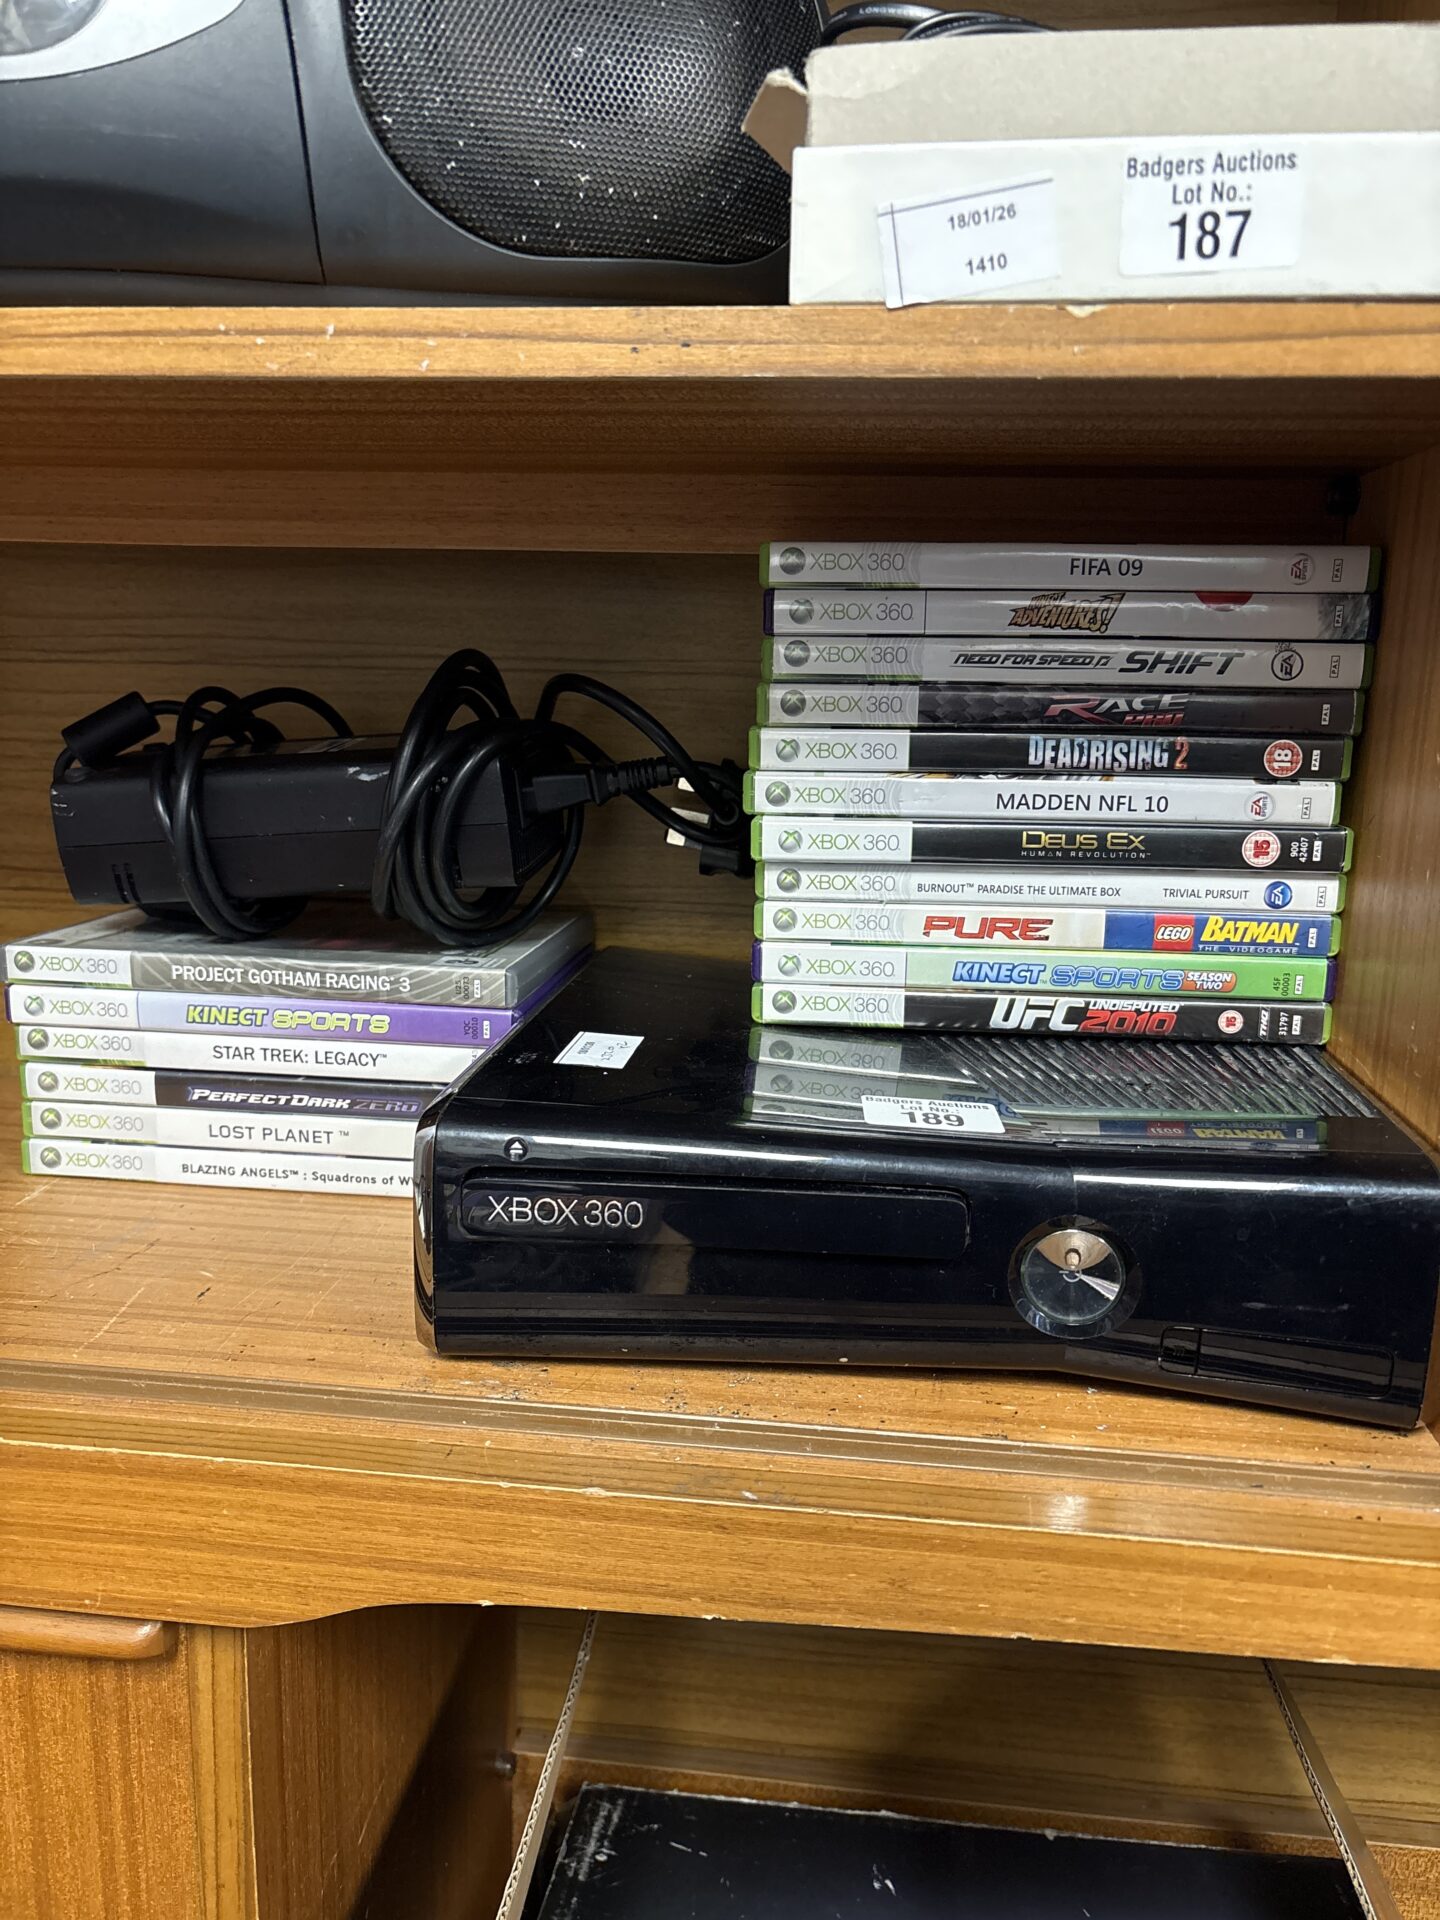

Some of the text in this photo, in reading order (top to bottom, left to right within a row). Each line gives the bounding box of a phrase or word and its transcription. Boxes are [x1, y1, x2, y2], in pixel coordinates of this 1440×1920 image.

[1126, 150, 1297, 179] Badgers Auctions
[1171, 182, 1252, 205] Lot No.:
[947, 204, 1017, 231] 18/01/26
[1169, 210, 1252, 261] 187
[965, 254, 1008, 275] 1410
[810, 553, 905, 571] XBOX 360
[1070, 558, 1143, 576] FIFA 09
[1334, 561, 1342, 579] PAL
[819, 603, 913, 620] XBOX 360
[814, 646, 909, 663] XBOX 360
[954, 651, 1245, 675] NEED FOR SPEED SHIFT
[810, 695, 903, 713] XBOX 360
[1044, 693, 1189, 725] RACE
[1321, 704, 1331, 724] PAL
[805, 742, 897, 759] XBOX 360
[1174, 736, 1190, 770] 2
[1273, 749, 1292, 769] 18
[794, 787, 886, 805] XBOX 360
[996, 793, 1169, 812] MADDEN NFL 10
[807, 834, 900, 851] XBOX 360
[1022, 831, 1098, 849] DEUS
[1253, 840, 1270, 858] 15
[1290, 842, 1299, 857] 900
[1299, 837, 1309, 862] 42407
[806, 875, 896, 892] XBOX 360
[977, 885, 1023, 895] PARADISE
[1028, 886, 1046, 895] THE
[1049, 886, 1097, 896] ULTIMATE
[1100, 887, 1121, 897] BOX
[1163, 888, 1249, 900] TRIVIAL PURSUIT
[801, 912, 891, 931] XBOX 360
[923, 915, 1054, 941] PURE
[1200, 916, 1299, 944] BATMAN
[1156, 926, 1192, 940] LEGO
[1229, 946, 1299, 954] VIDEOGAME
[39, 956, 117, 974] XBOX 360
[806, 959, 895, 977] XBOX 360
[172, 965, 244, 983] PROJECT
[248, 970, 321, 988] GOTHAM
[399, 978, 410, 992] 3
[1050, 966, 1184, 990] SPORTS
[1187, 972, 1232, 981] SEASON
[1195, 981, 1223, 990] TWO
[49, 1000, 128, 1018] XBOX 360
[801, 996, 889, 1013] XBOX 360
[1089, 1000, 1180, 1012] UNDISPUTED
[186, 1004, 391, 1034] KINECT SPORTS
[990, 997, 1085, 1031] UFC
[1078, 1011, 1177, 1035] 2010
[1225, 1016, 1237, 1028] 15
[1259, 1009, 1269, 1036] THQ
[1279, 1012, 1289, 1036] 31797
[53, 1033, 132, 1051] XBOX 360
[213, 1045, 255, 1060] STAR
[261, 1048, 308, 1063] TREK:
[64, 1077, 142, 1095] XBOX 360
[353, 1100, 418, 1112] ZERO
[865, 1096, 990, 1110] Badgers Auctions
[66, 1115, 143, 1131] XBOX 360
[901, 1112, 965, 1127] 189
[209, 1124, 255, 1140] LOST
[263, 1128, 333, 1144] PLANET
[66, 1154, 142, 1170] XBOX 360
[182, 1164, 235, 1176] BLAZING
[312, 1171, 376, 1184] Squadrons
[382, 1176, 394, 1185] of
[487, 1195, 643, 1229] XBOX 360
